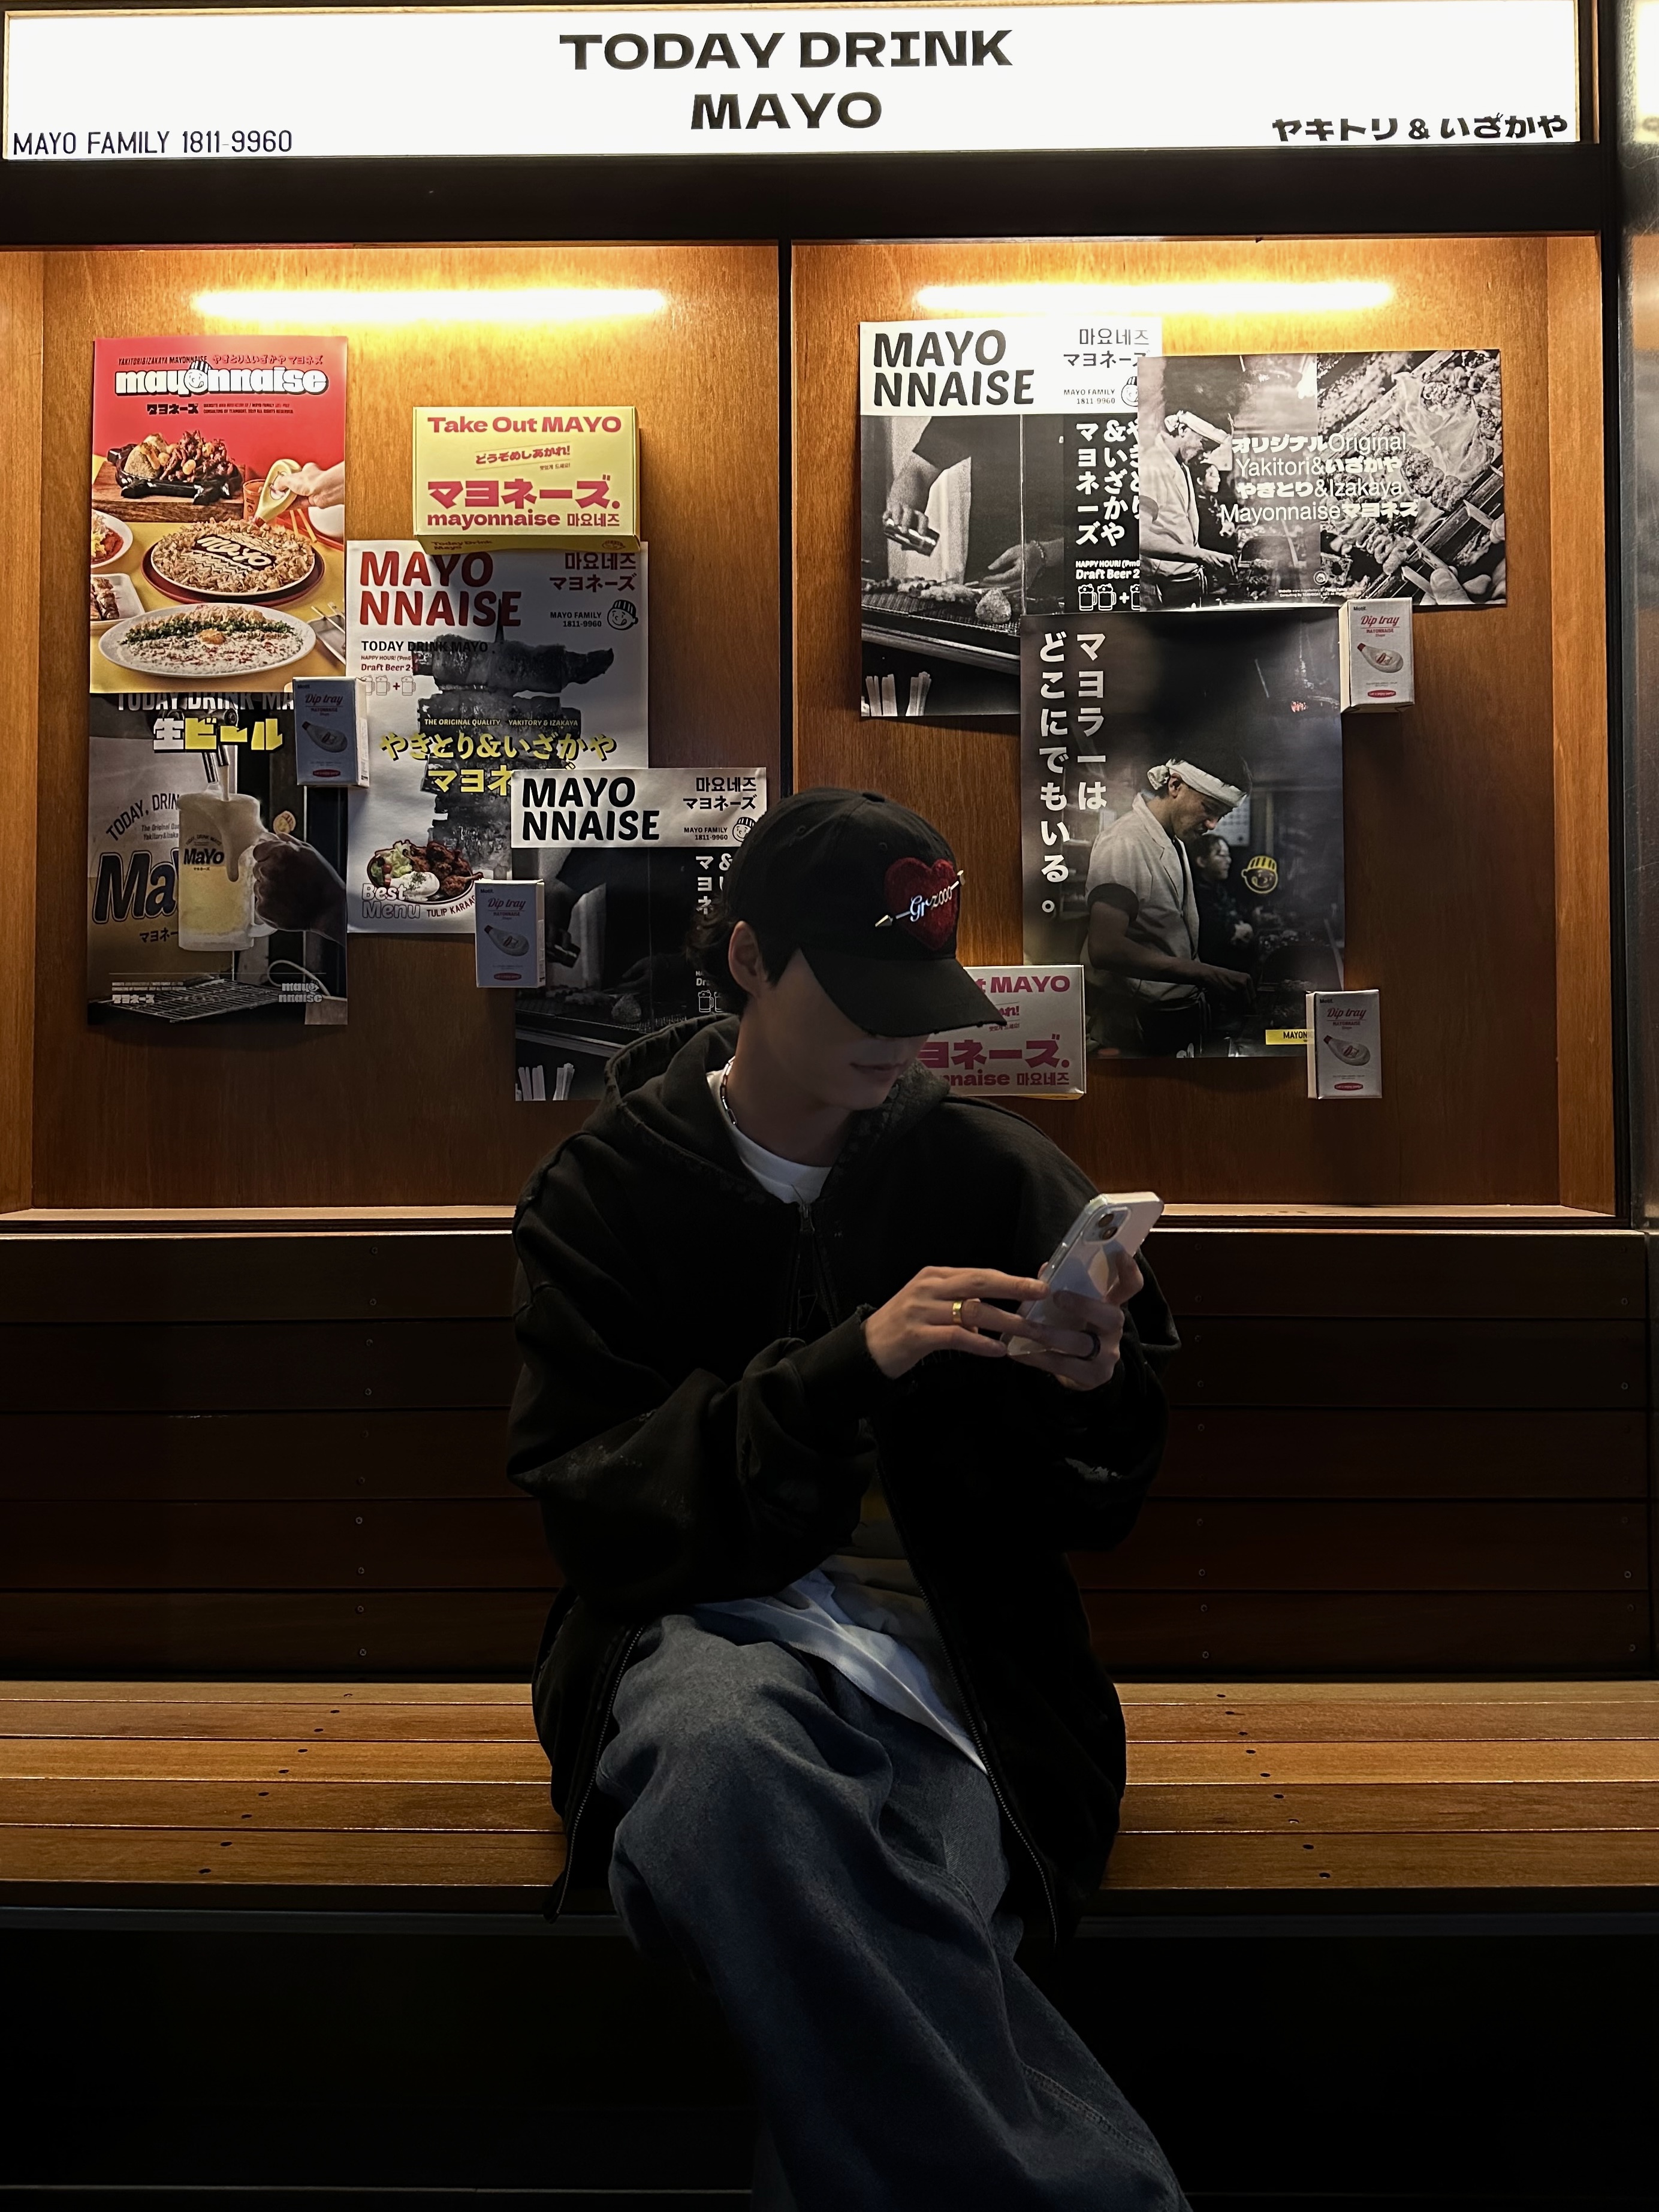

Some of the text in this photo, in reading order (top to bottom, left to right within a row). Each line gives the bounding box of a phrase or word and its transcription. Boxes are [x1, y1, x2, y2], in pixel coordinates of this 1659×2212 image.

[559, 30, 1014, 70] TODAY DRINK
[691, 92, 882, 129] MAYO
[1272, 114, 1568, 141] ヤキトリ & いざかや
[13, 129, 292, 155] MAYO FAMILY 1811-9960
[1079, 328, 1150, 346] 마요네즈
[873, 329, 1006, 367] MAYO
[115, 364, 329, 398] mayonnaise
[873, 369, 1034, 407] NNAISE
[147, 403, 198, 415] マヨネーズ
[427, 416, 622, 433] Take Out MAYO
[1232, 432, 1406, 454] オリジナルOriginal
[1235, 456, 1402, 477] Yakitori&いざかや
[427, 474, 620, 509] マヨネーズ.
[1075, 423, 1099, 545] マヨネーズ
[1236, 479, 1403, 500] やきとり&Izakaya
[427, 509, 561, 531] mayonnaise
[567, 513, 620, 527] 마요네즈
[360, 551, 493, 587] MAYO
[565, 552, 637, 570] 마요네즈
[550, 572, 637, 593] マヨネーズ
[1076, 569, 1105, 580] Draft
[1106, 569, 1132, 580] Beer
[360, 591, 522, 627] NNAISE
[1361, 615, 1400, 627] Dip tray
[361, 641, 488, 652] TODAY DRINK MAYO
[305, 693, 343, 705] Dip tray
[1076, 633, 1106, 811] マヨラーは
[153, 717, 284, 752] 生ビール
[379, 732, 617, 761] やきとり&いざかや
[1039, 630, 1070, 913] どこにでもいる。
[522, 777, 636, 807] MAYO
[696, 777, 756, 793] 마요네즈
[683, 795, 758, 811] マヨネーズ
[106, 800, 149, 841] TODAY,
[522, 810, 660, 840] NNAISE
[183, 848, 225, 865] MaYo
[362, 883, 408, 901] Best
[362, 900, 421, 919] Menu
[427, 908, 447, 918] TULIP
[488, 898, 526, 910] Dip tray
[991, 975, 1070, 993] MAYO
[1327, 1008, 1367, 1019] Dip tray
[1016, 1072, 1070, 1086] 마요네즈
